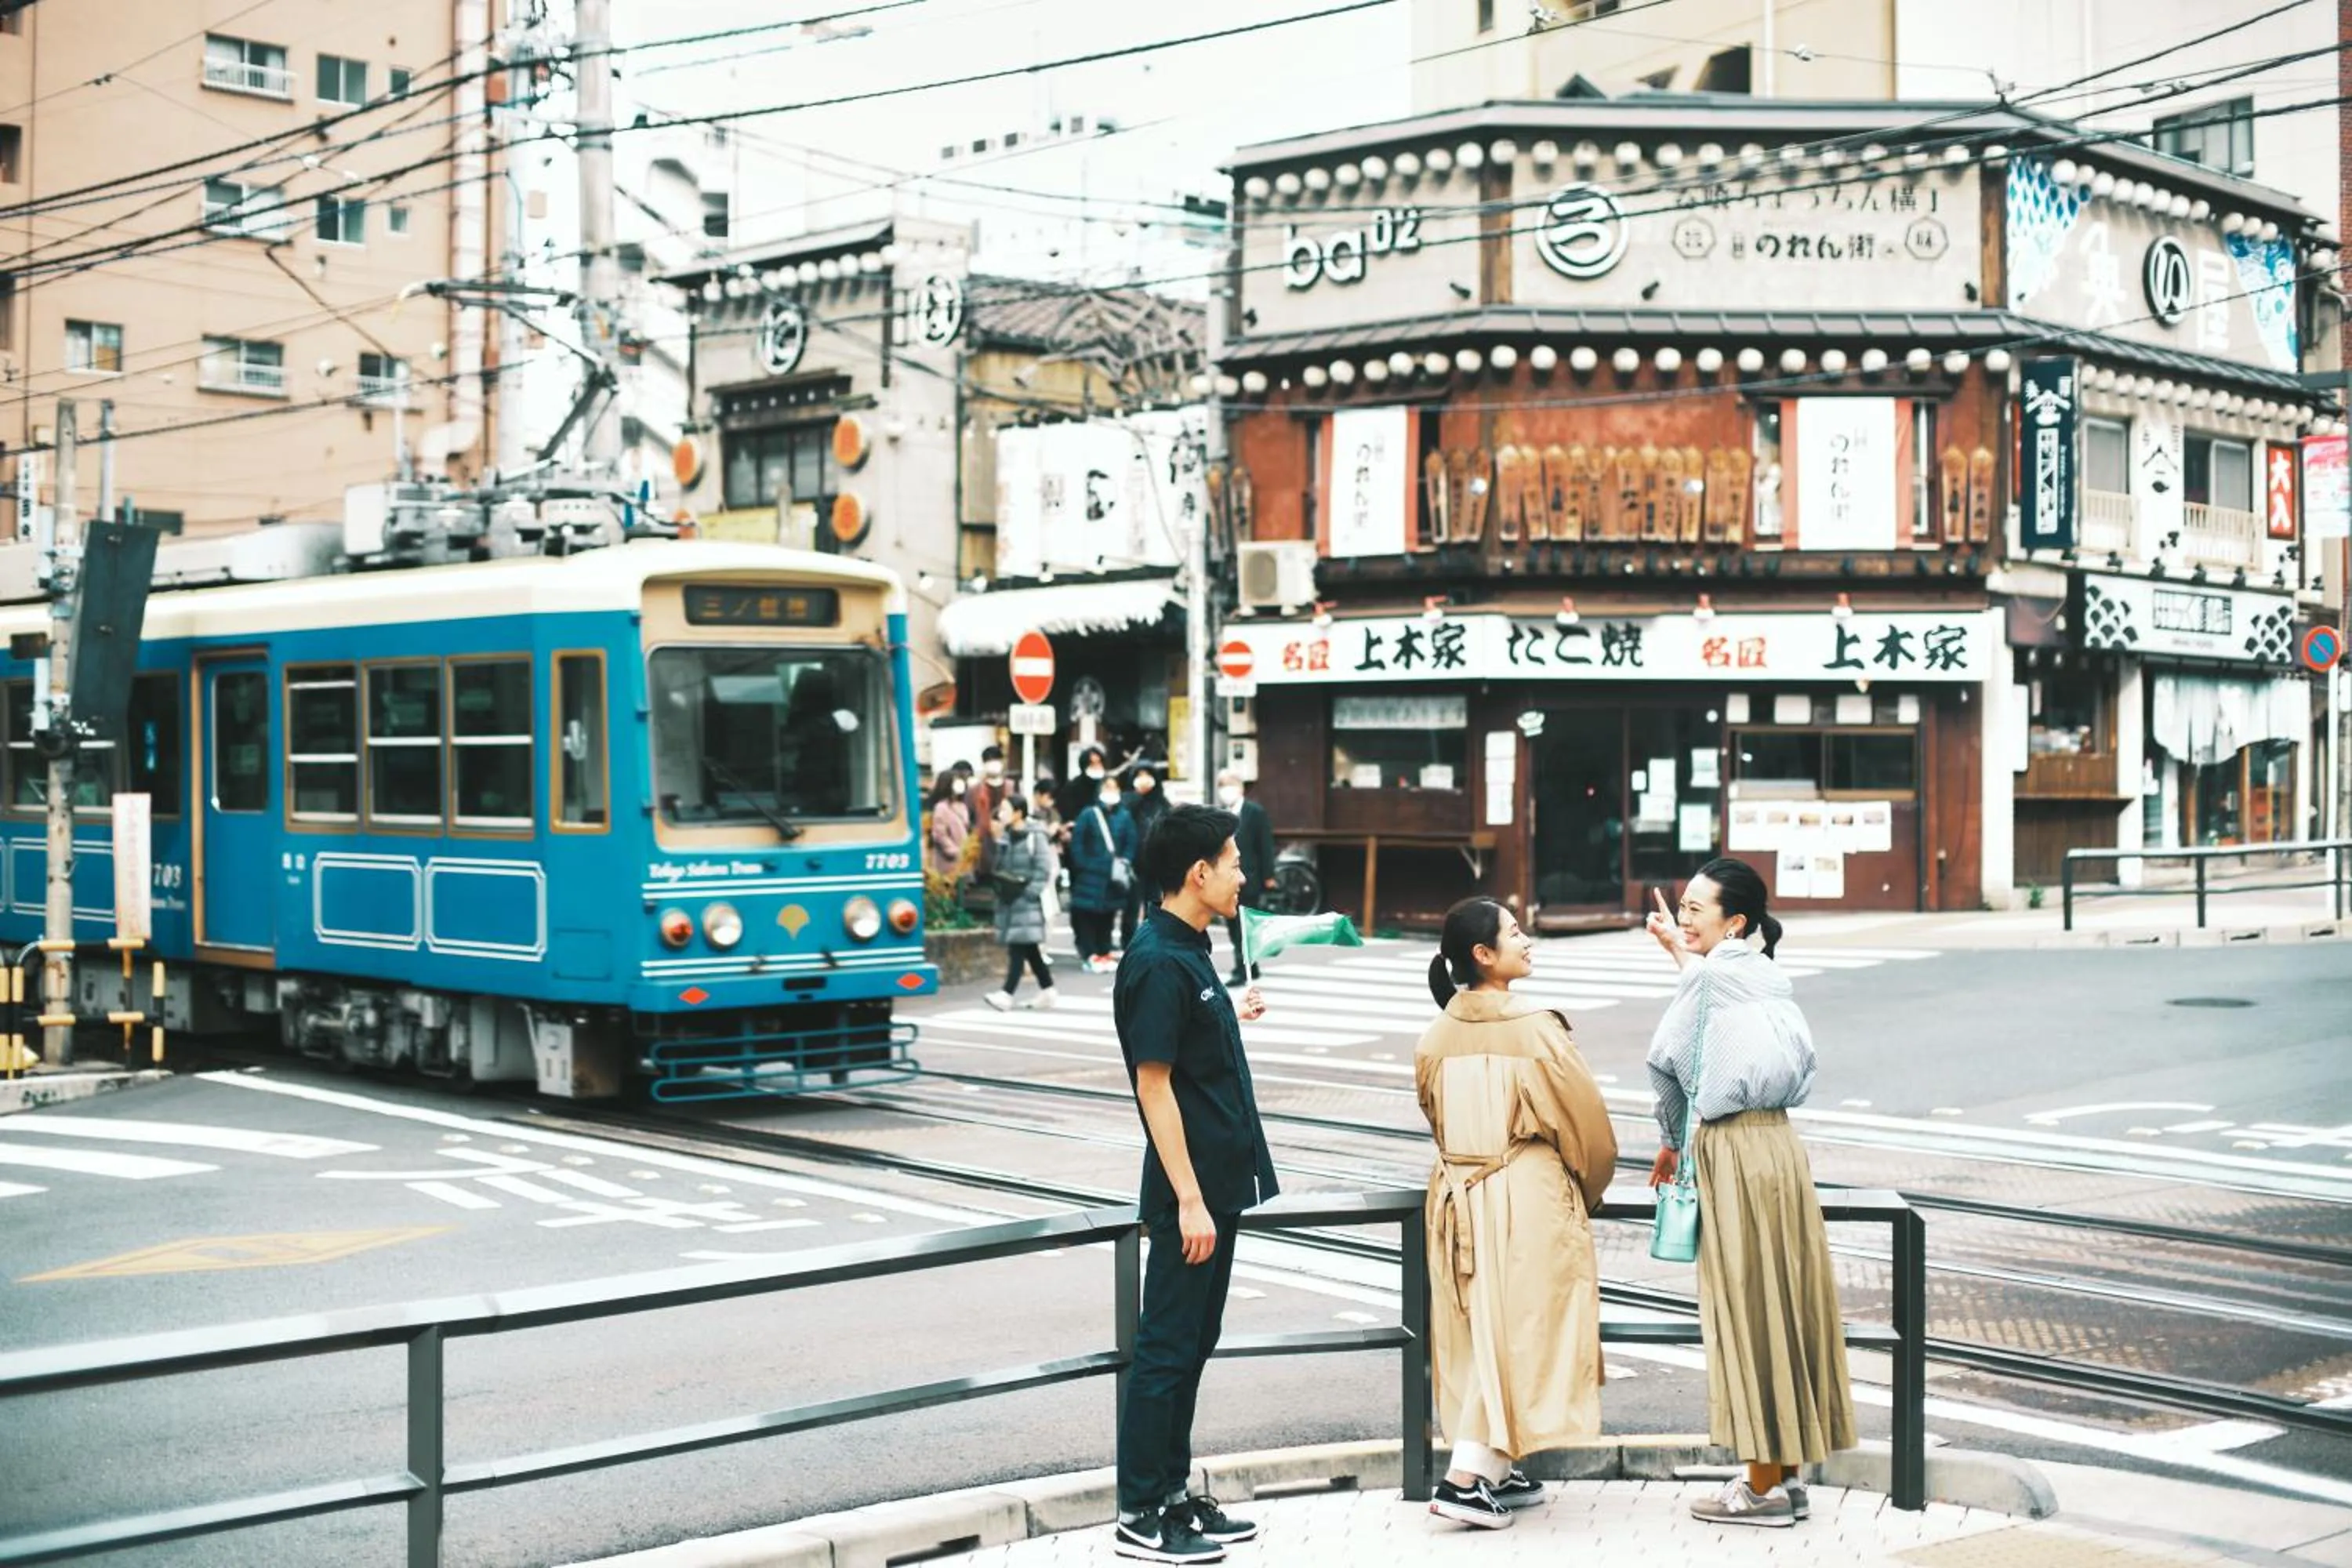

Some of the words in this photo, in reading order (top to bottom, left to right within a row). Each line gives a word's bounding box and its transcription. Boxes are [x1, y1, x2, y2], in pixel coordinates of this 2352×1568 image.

[2270, 451, 2292, 529] 大入
[1282, 638, 1330, 673] 名匠
[1355, 622, 1467, 671] 上木家
[1508, 621, 1645, 669] たこ焼
[1701, 636, 1769, 669] 名匠
[1823, 622, 1969, 672] 上木家
[865, 852, 910, 869] 7703
